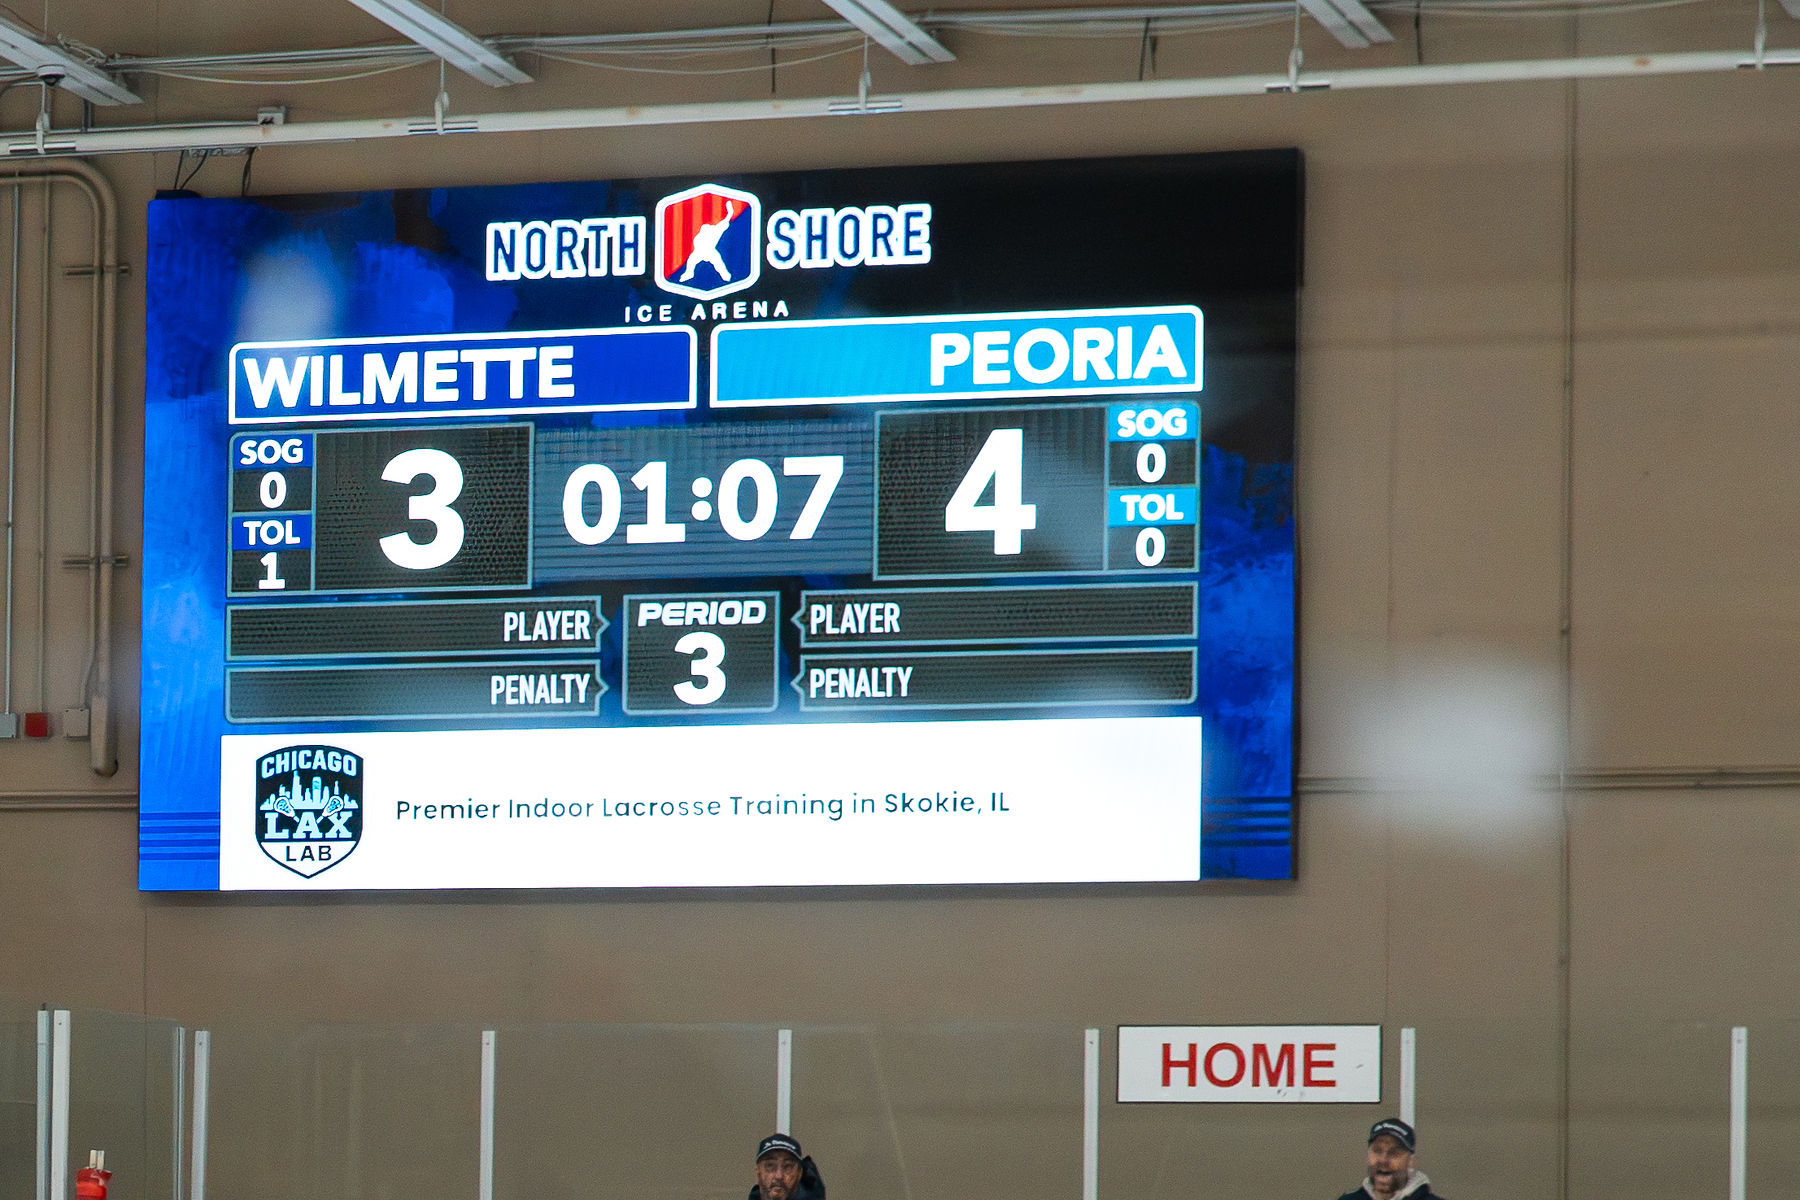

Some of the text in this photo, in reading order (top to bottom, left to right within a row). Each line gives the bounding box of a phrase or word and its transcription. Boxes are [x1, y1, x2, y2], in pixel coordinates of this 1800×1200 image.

[487, 204, 931, 281] NORTH SHORE
[625, 299, 790, 323] ICE ARENA
[930, 325, 1187, 386] PEORIA
[242, 345, 575, 409] WILMETTE
[1117, 408, 1188, 438] SOG
[240, 438, 304, 466] SOG
[1136, 446, 1167, 484] 0
[259, 472, 287, 510] 0
[562, 456, 845, 546] 01:07
[945, 428, 1036, 555] 4
[1120, 493, 1184, 521] TOL
[379, 448, 466, 570] 3
[242, 520, 301, 546] TOL
[1136, 527, 1166, 565] 0
[258, 552, 286, 590] 1
[503, 610, 591, 642] PLAYER
[637, 600, 767, 628] PERIOD
[810, 603, 901, 636] PLAYER
[672, 631, 727, 705] 3
[810, 667, 914, 699] PENALTY
[490, 673, 590, 705] PENALTY
[261, 749, 357, 780] CHICAGO
[396, 790, 1009, 821] Premier Indoor Lacrosse Training in Skokie, IL
[264, 811, 353, 840] LAX
[286, 845, 332, 864] LAB
[1161, 1042, 1337, 1088] HOME
